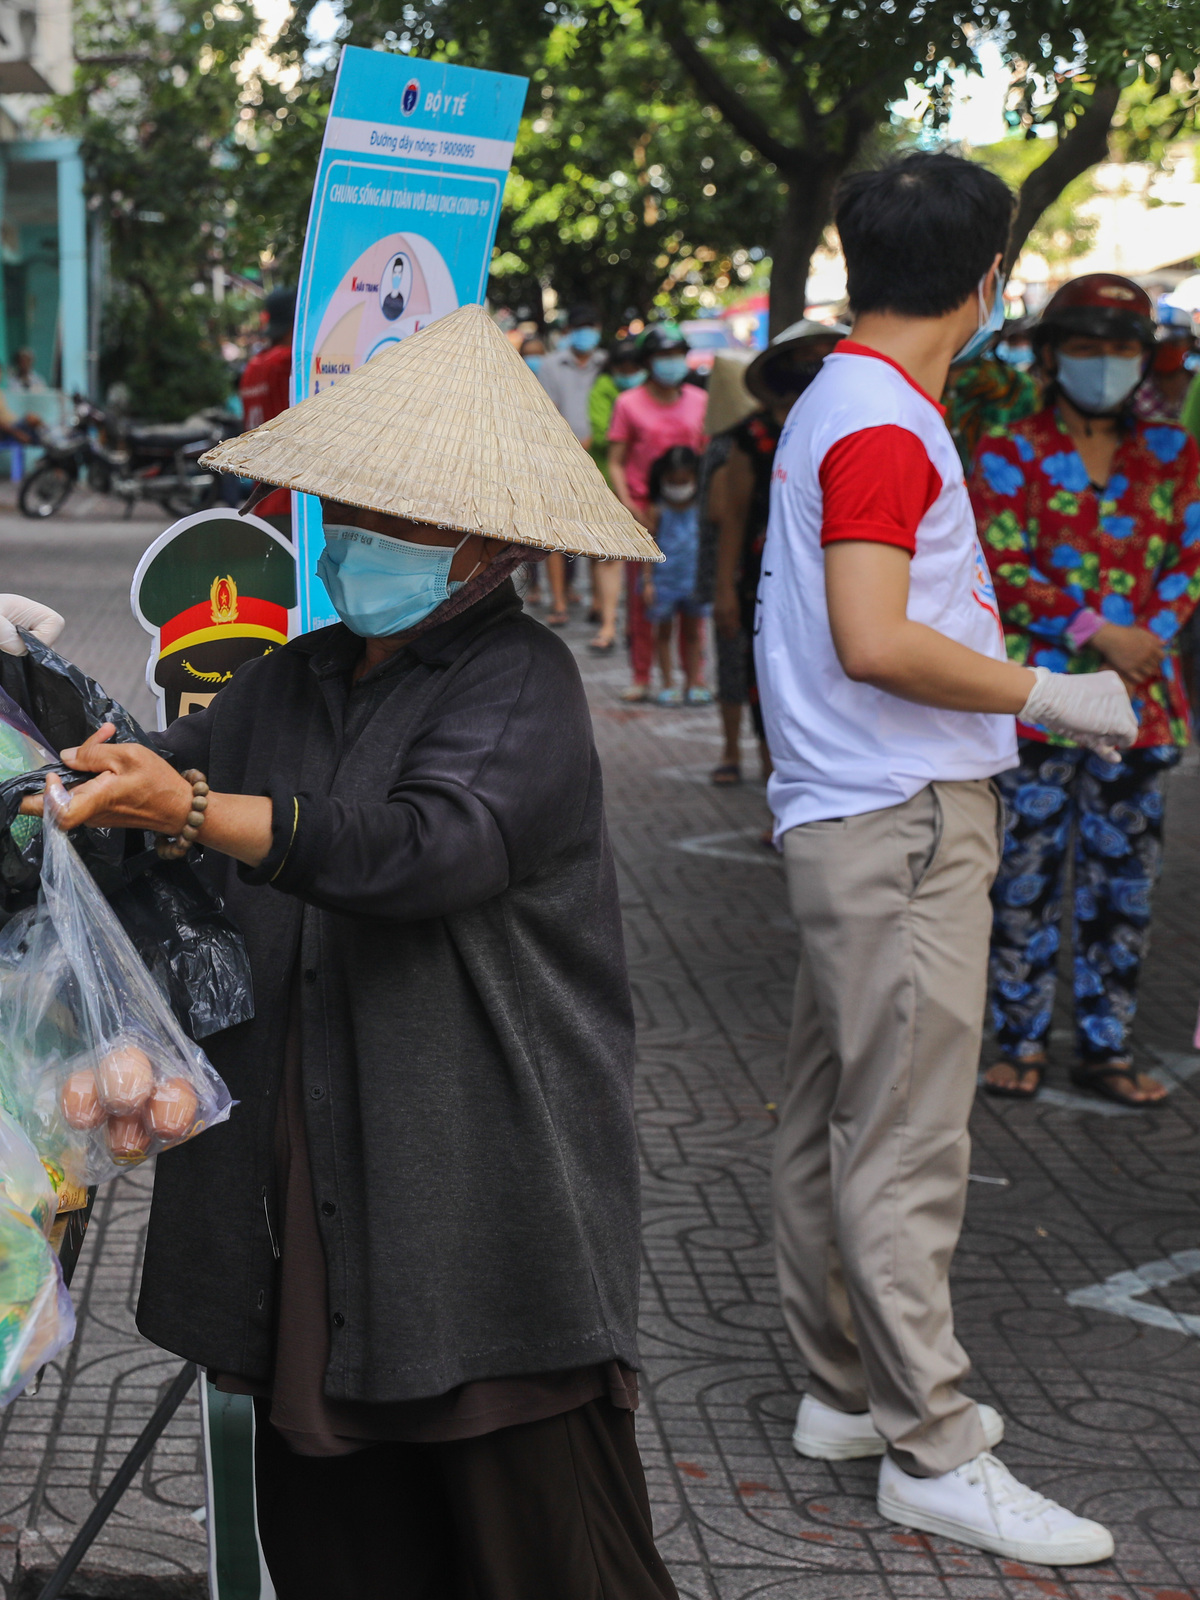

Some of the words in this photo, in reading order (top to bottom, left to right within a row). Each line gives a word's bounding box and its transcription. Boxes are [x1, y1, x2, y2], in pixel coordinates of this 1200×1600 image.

[424, 90, 442, 118] BỘ
[443, 95, 452, 114] Y
[452, 92, 469, 116] TẾ
[370, 130, 398, 152] Đường
[399, 134, 415, 153] dây
[440, 140, 476, 158] 19009095
[330, 184, 359, 204] CHUNG
[357, 181, 381, 206] SỐNG
[379, 189, 393, 207] AN
[392, 188, 413, 209] TOÀN
[439, 195, 458, 218] DỊCH
[456, 197, 490, 217] COVID-19
